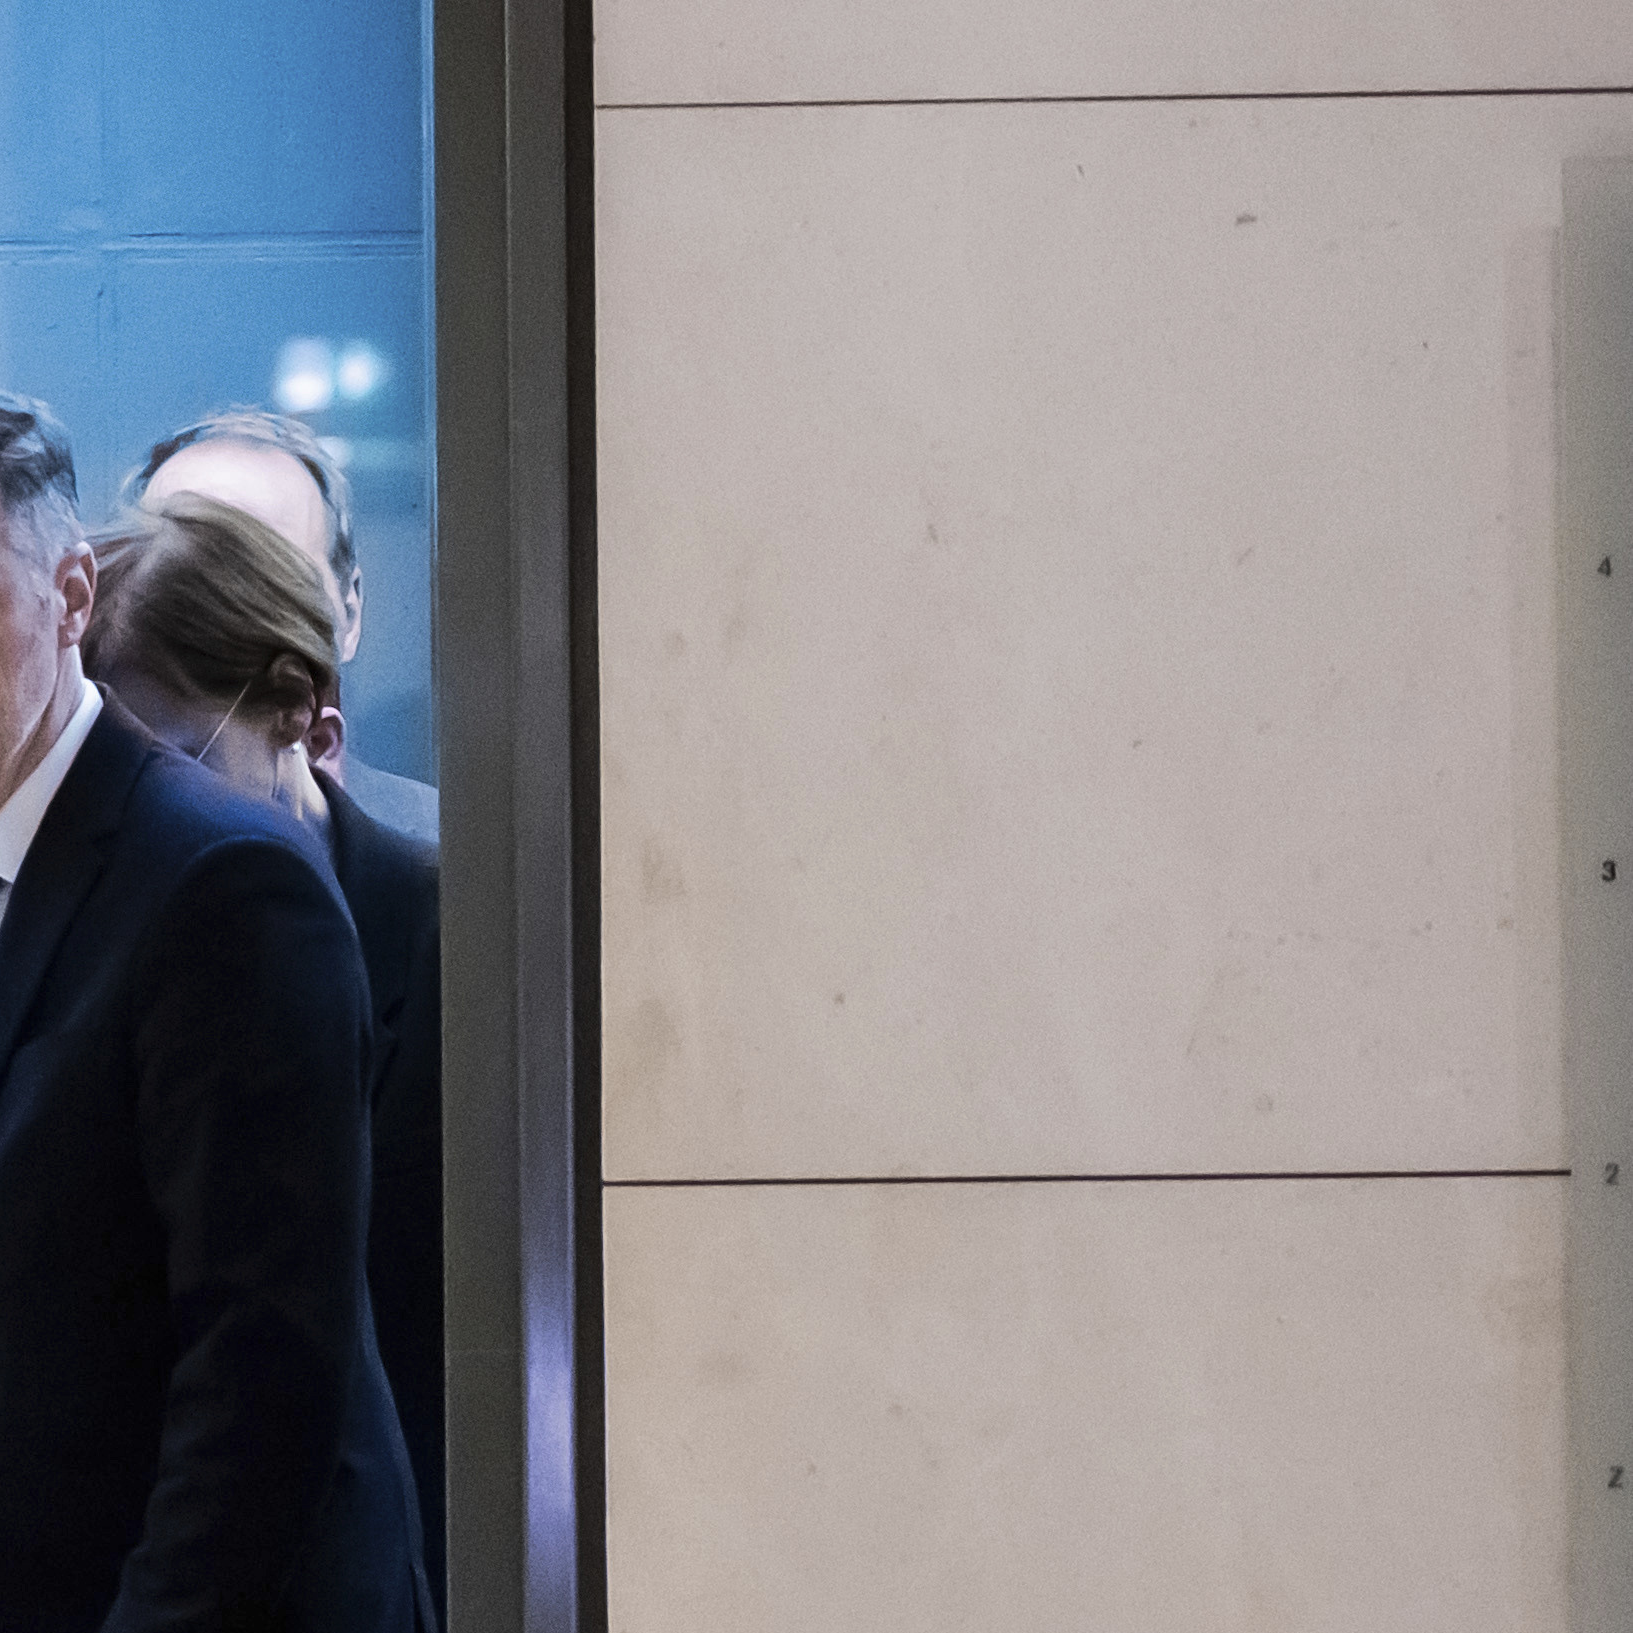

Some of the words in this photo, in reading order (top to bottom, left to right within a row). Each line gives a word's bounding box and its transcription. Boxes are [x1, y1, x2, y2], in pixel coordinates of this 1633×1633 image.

[1597, 556, 1612, 578] 4
[1601, 860, 1617, 883] 3
[1605, 1162, 1620, 1186] 2
